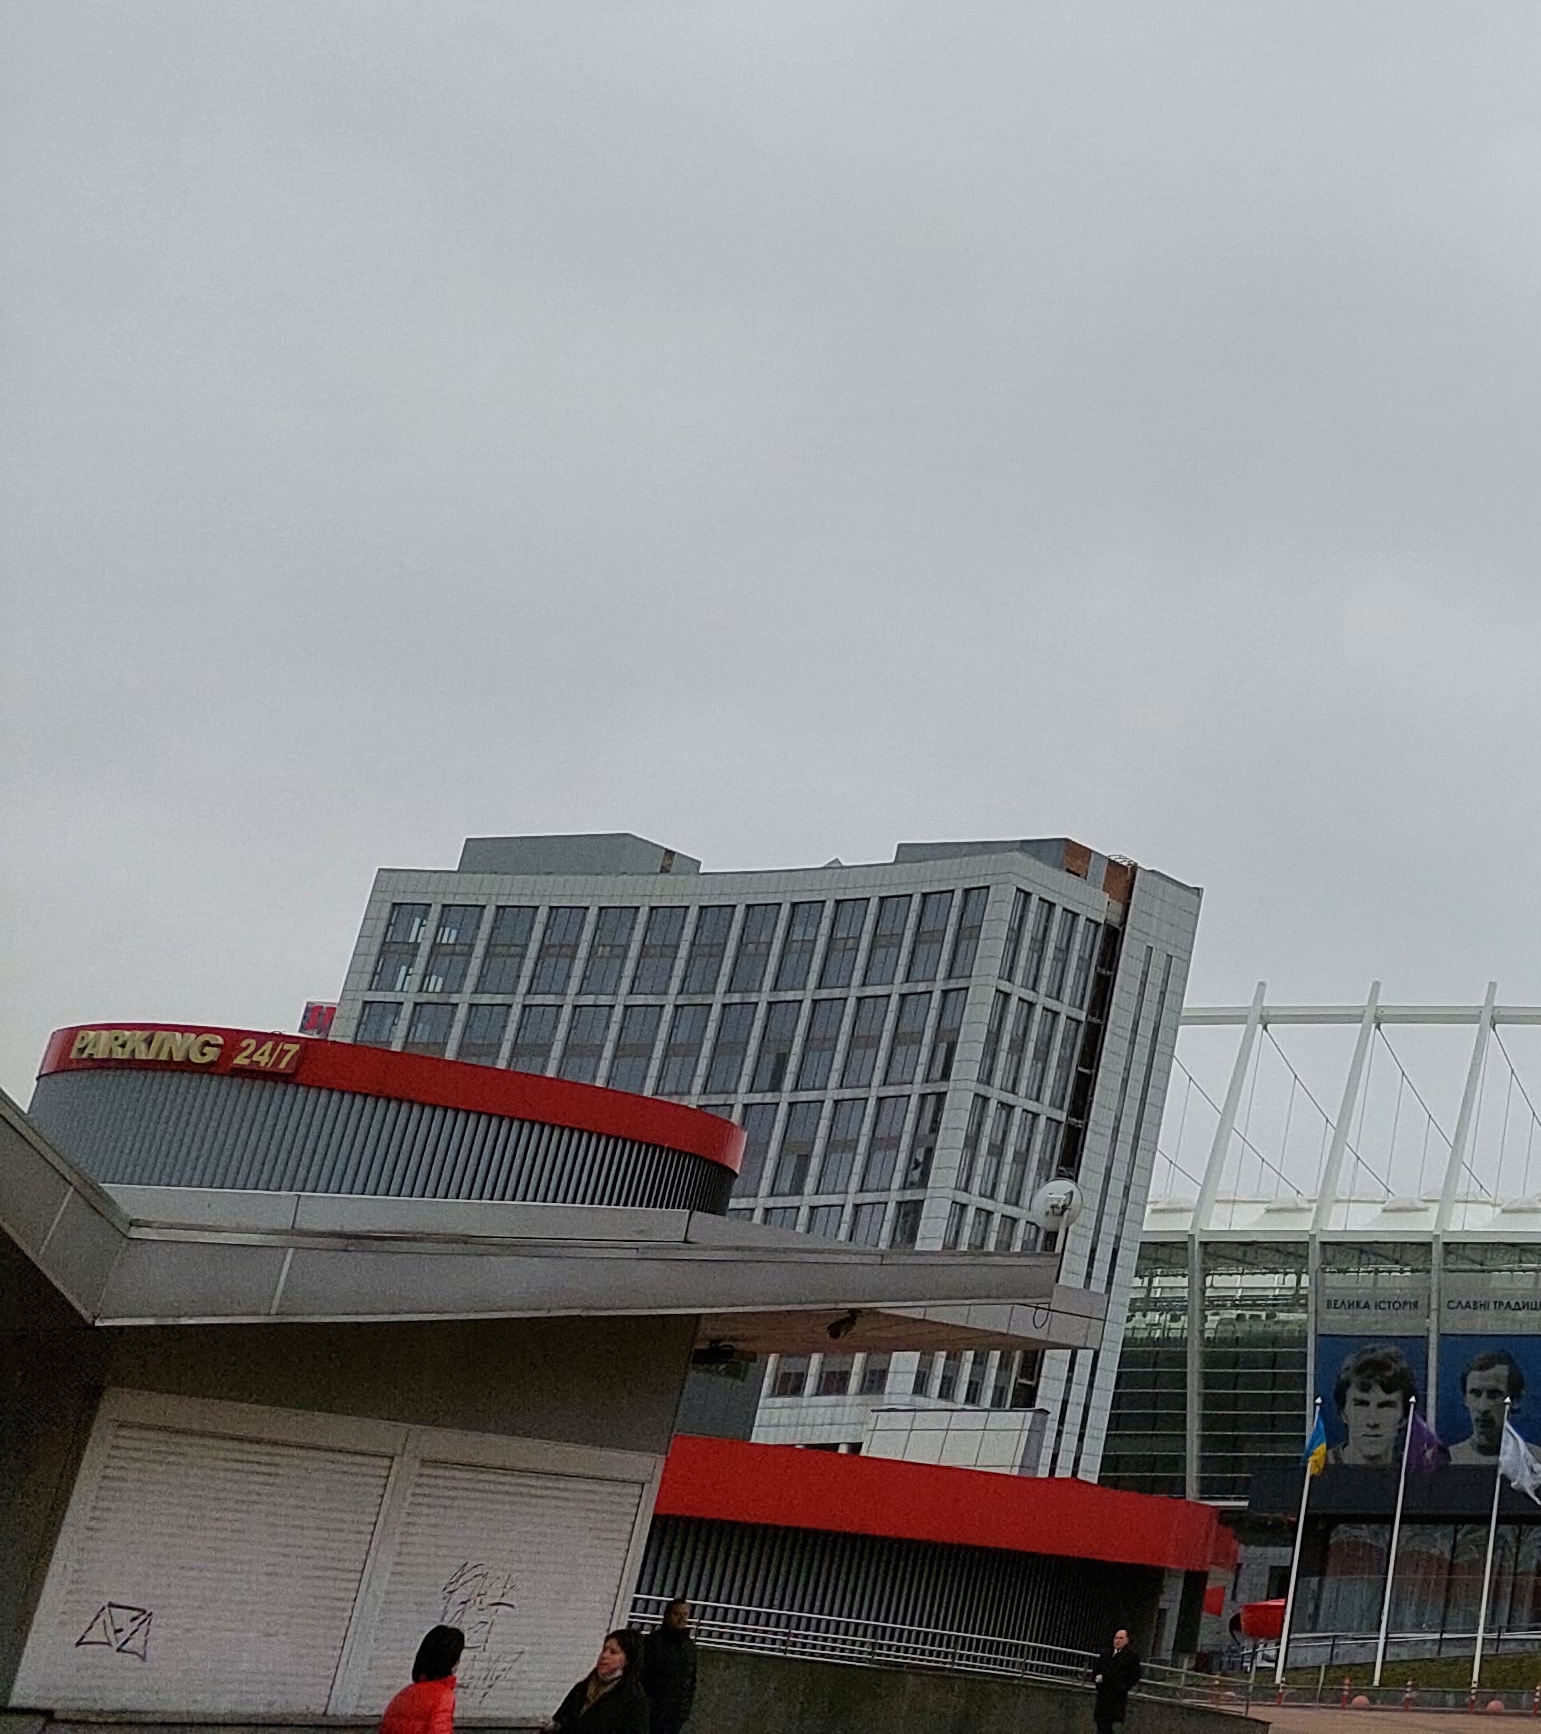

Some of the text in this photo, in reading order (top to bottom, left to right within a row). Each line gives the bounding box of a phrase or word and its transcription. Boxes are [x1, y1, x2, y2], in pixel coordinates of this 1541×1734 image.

[70, 1030, 300, 1069] PARKING 24/7
[1326, 1299, 1419, 1311] ВЕЛИКА ІСТОРІЯ
[1447, 1299, 1490, 1311] СЛАВНІ
